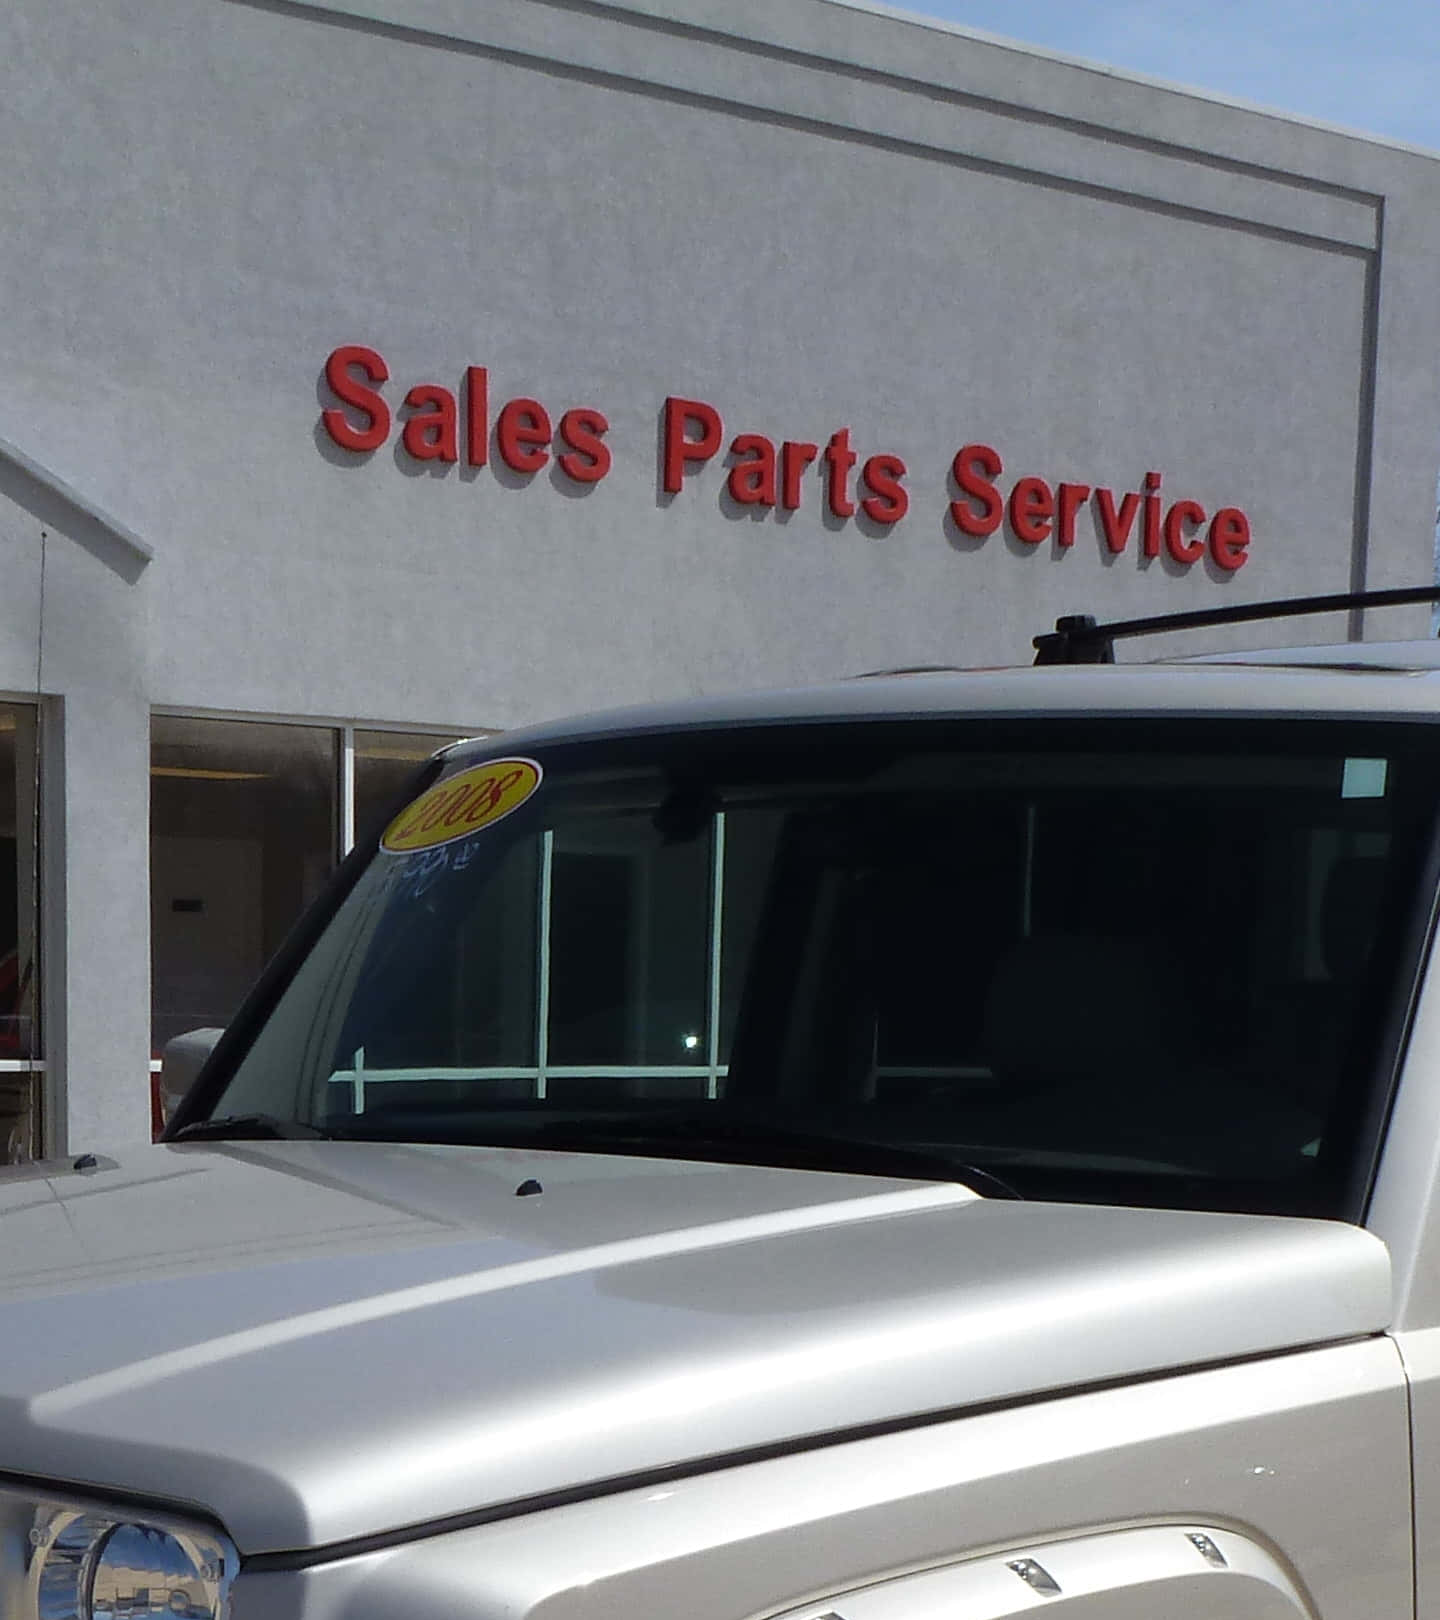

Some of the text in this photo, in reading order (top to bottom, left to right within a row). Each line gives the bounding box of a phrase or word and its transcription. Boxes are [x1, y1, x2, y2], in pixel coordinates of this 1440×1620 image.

[323, 345, 1251, 571] Sales Parts Service
[392, 769, 524, 841] 2008
